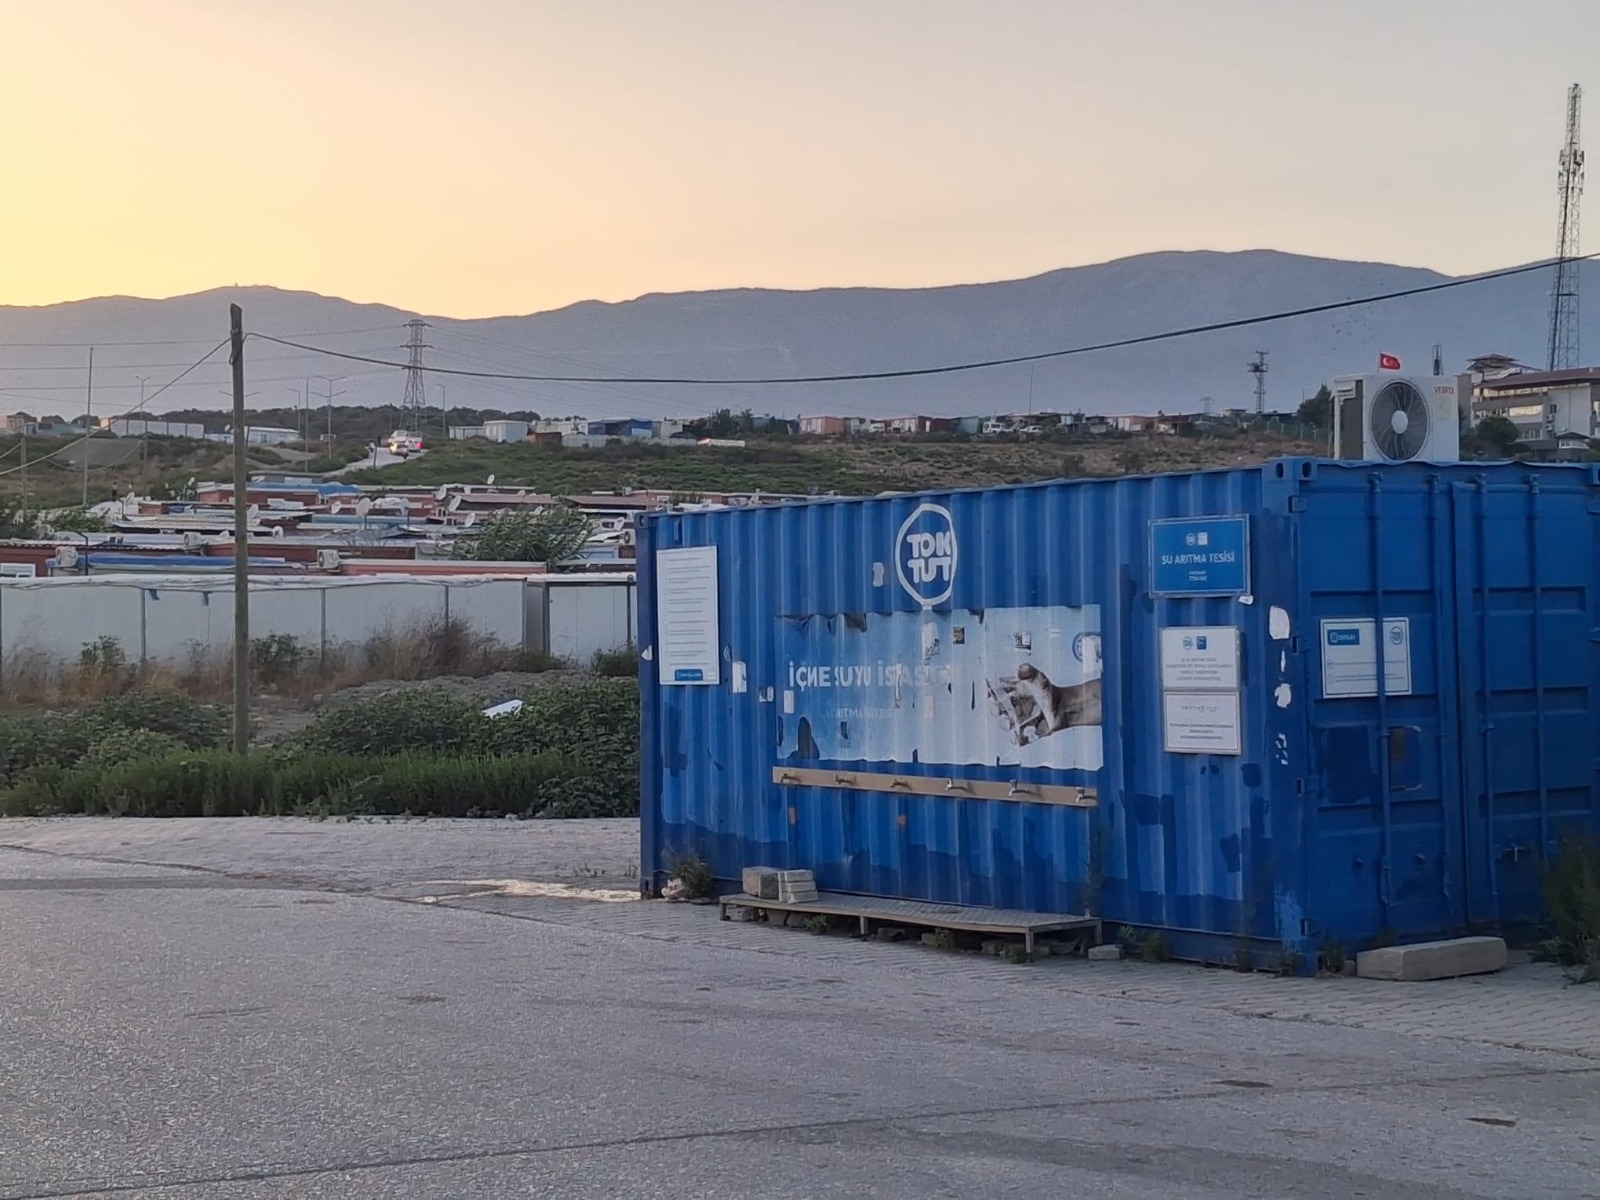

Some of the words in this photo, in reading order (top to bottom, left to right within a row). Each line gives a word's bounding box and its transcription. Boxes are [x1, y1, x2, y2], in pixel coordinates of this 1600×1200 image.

[907, 532, 951, 558] TOK
[907, 557, 951, 584] TUT
[1161, 555, 1173, 565] SU
[1174, 553, 1207, 565] ARITMA
